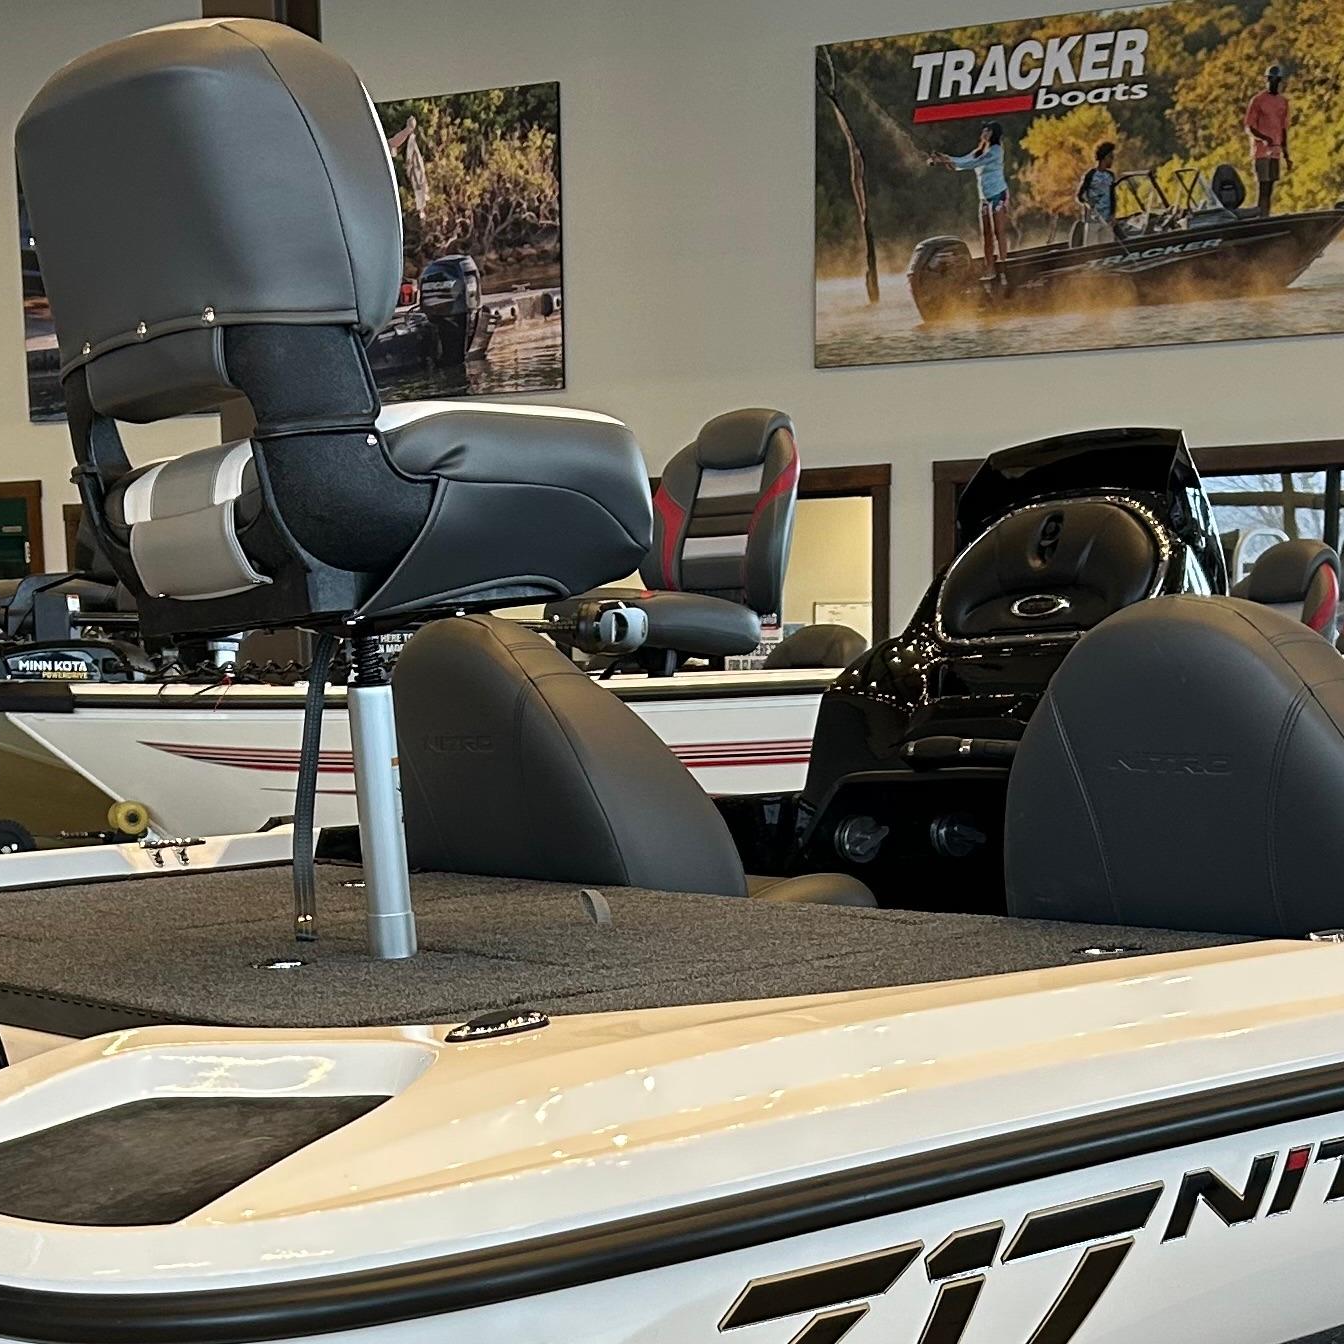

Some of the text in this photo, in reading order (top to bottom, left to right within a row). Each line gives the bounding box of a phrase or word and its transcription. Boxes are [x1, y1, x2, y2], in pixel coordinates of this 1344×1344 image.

[912, 28, 1149, 101] TRACKER
[1035, 80, 1148, 110] boats
[1087, 239, 1222, 269] TRACKER
[18, 660, 88, 671] MINN KOTA
